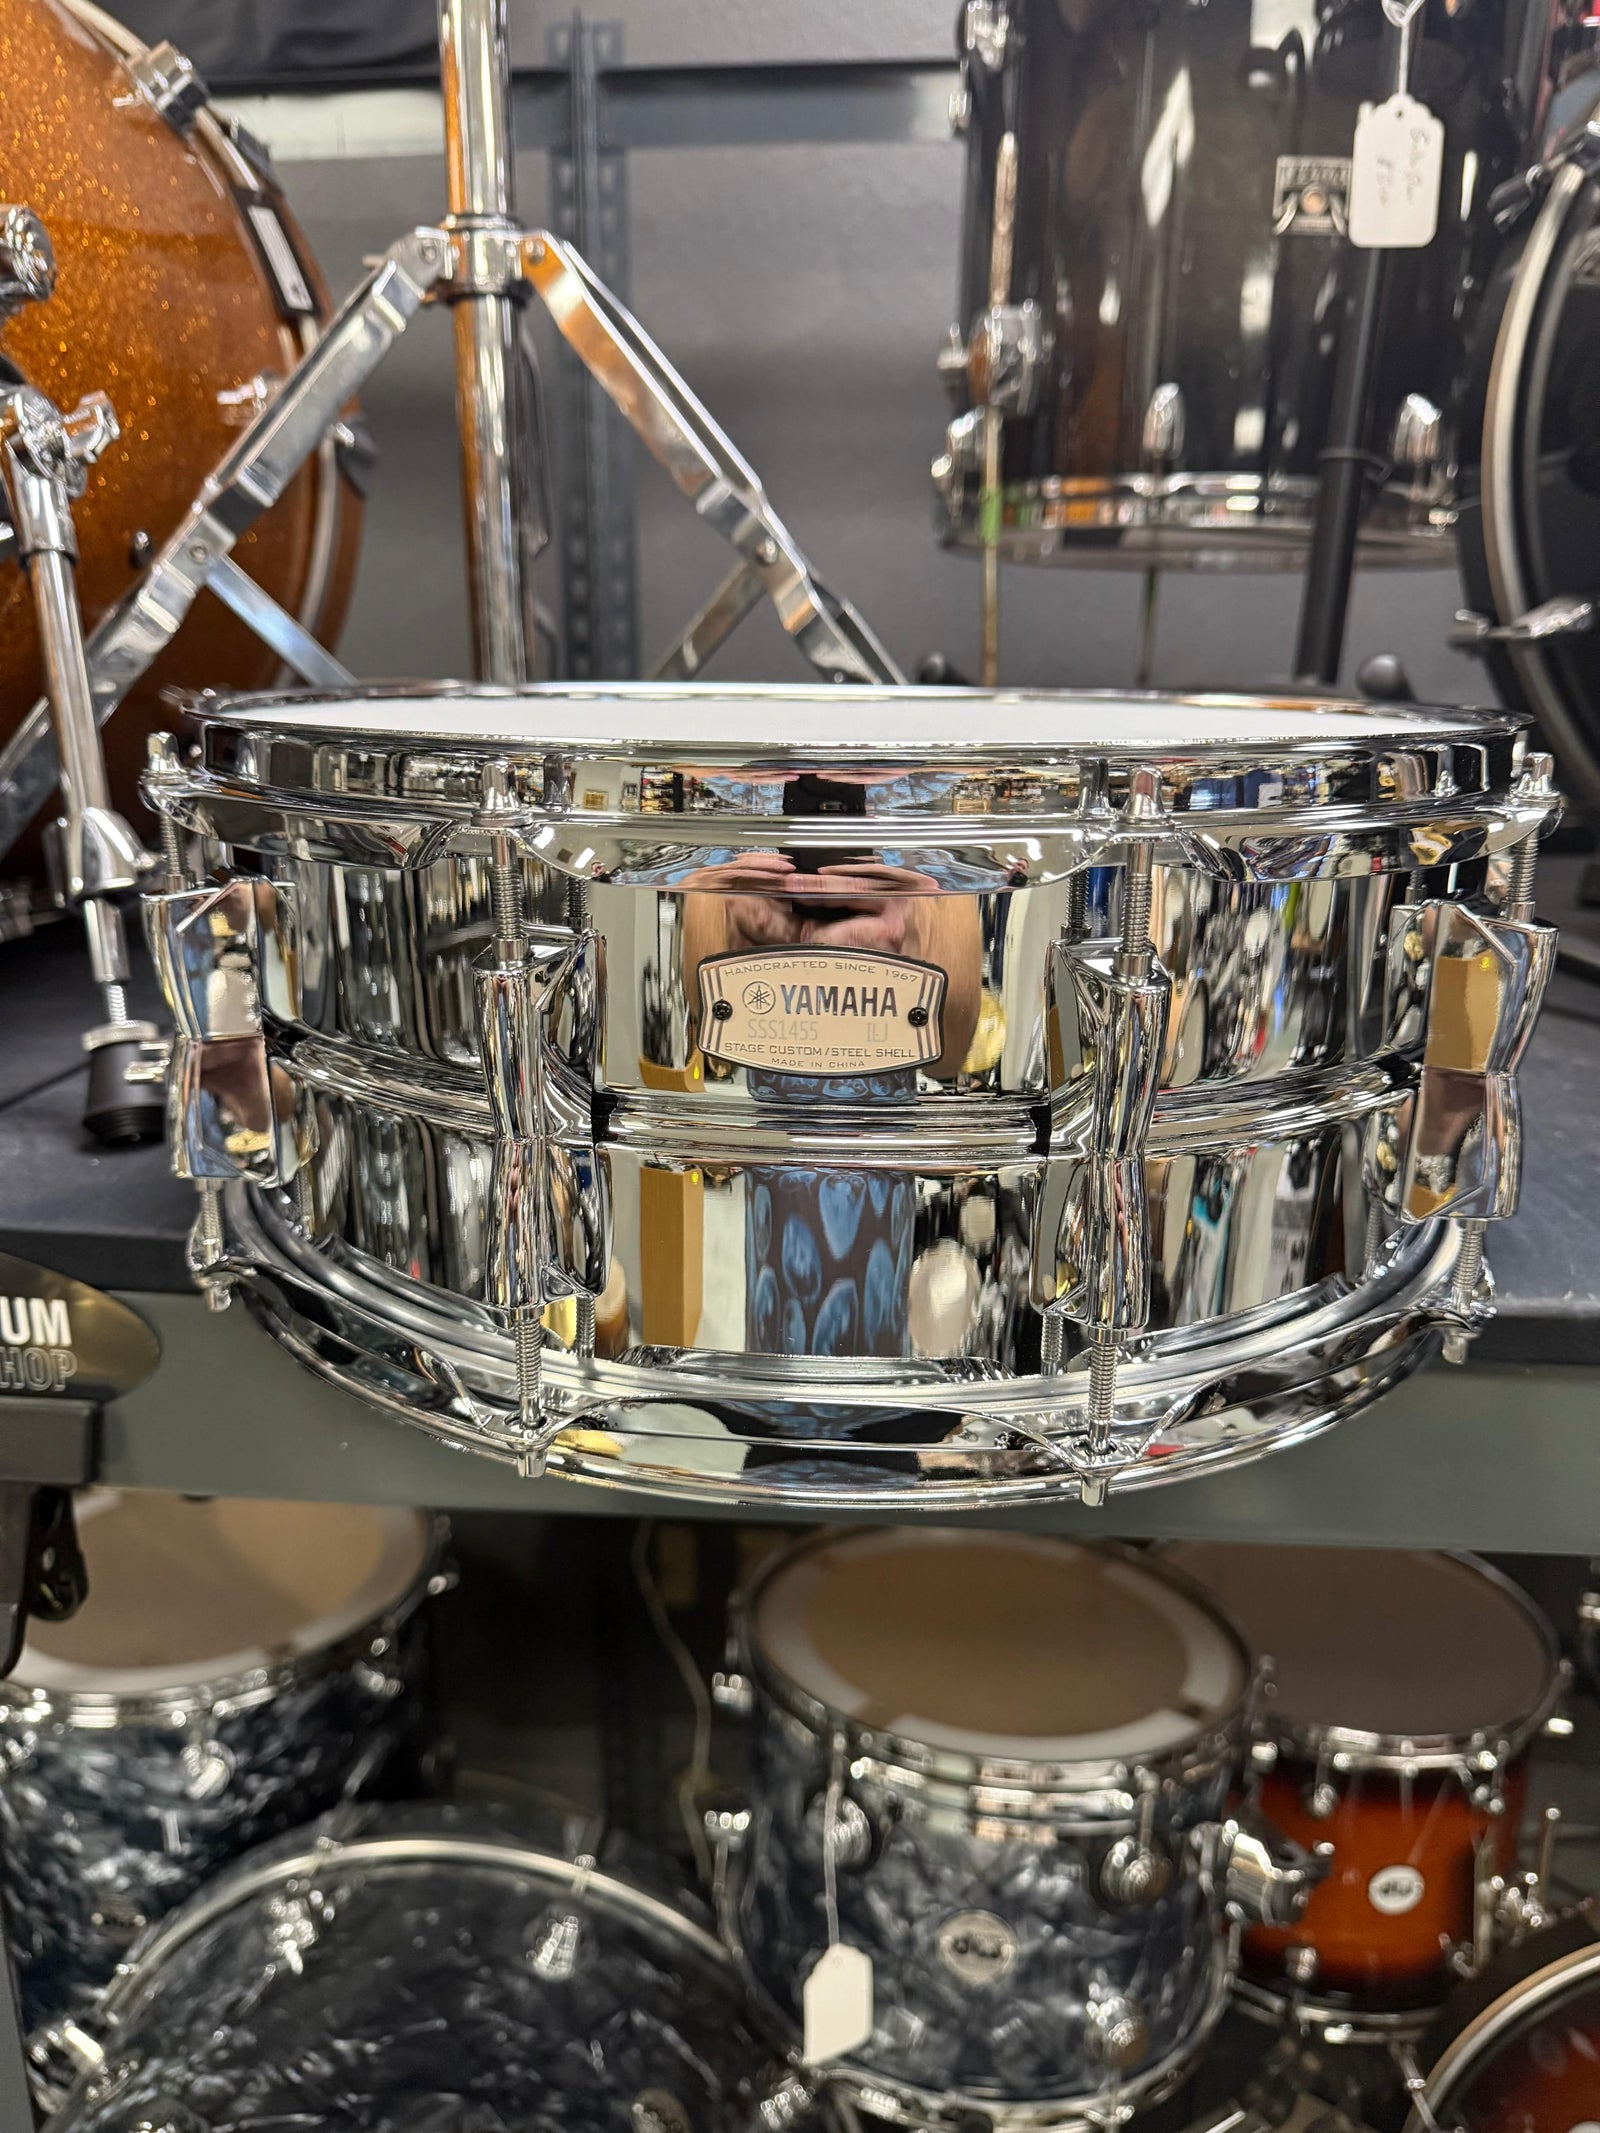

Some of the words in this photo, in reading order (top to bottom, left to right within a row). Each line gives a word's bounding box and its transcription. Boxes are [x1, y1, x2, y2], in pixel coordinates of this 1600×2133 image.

[724, 960, 828, 977] HANDCRAFTED
[835, 962, 876, 974] SINCE
[884, 968, 918, 983] 1967
[780, 984, 898, 1017] YAMAHA
[748, 1018, 819, 1041] SSS1455
[724, 1042, 766, 1054] STAGE
[875, 1048, 916, 1058] SHELL
[771, 1057, 804, 1068] MADE
[829, 1060, 866, 1069] CHINA
